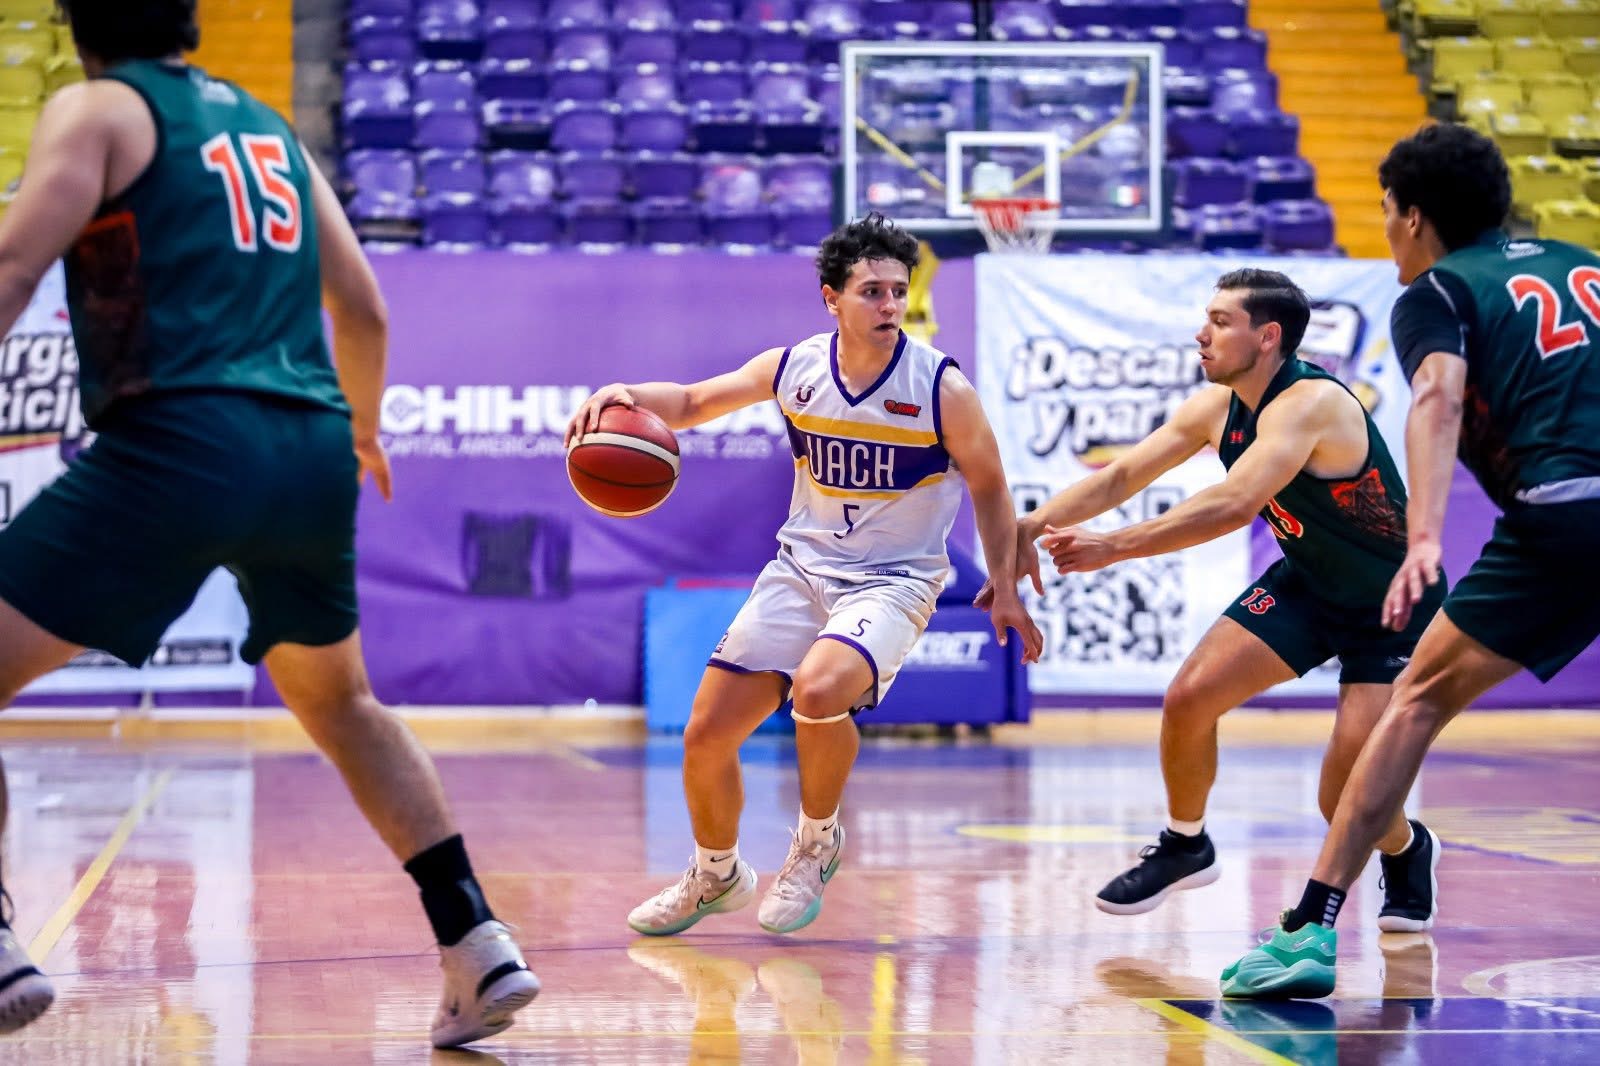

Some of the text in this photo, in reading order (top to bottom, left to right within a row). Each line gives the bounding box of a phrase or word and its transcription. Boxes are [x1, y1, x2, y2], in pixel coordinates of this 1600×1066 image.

[200, 131, 302, 254] 15
[1008, 337, 1203, 400] ¡Descar
[806, 434, 896, 488] UACH
[833, 503, 860, 540] 5
[1240, 586, 1276, 615] 13
[850, 617, 873, 637] 5
